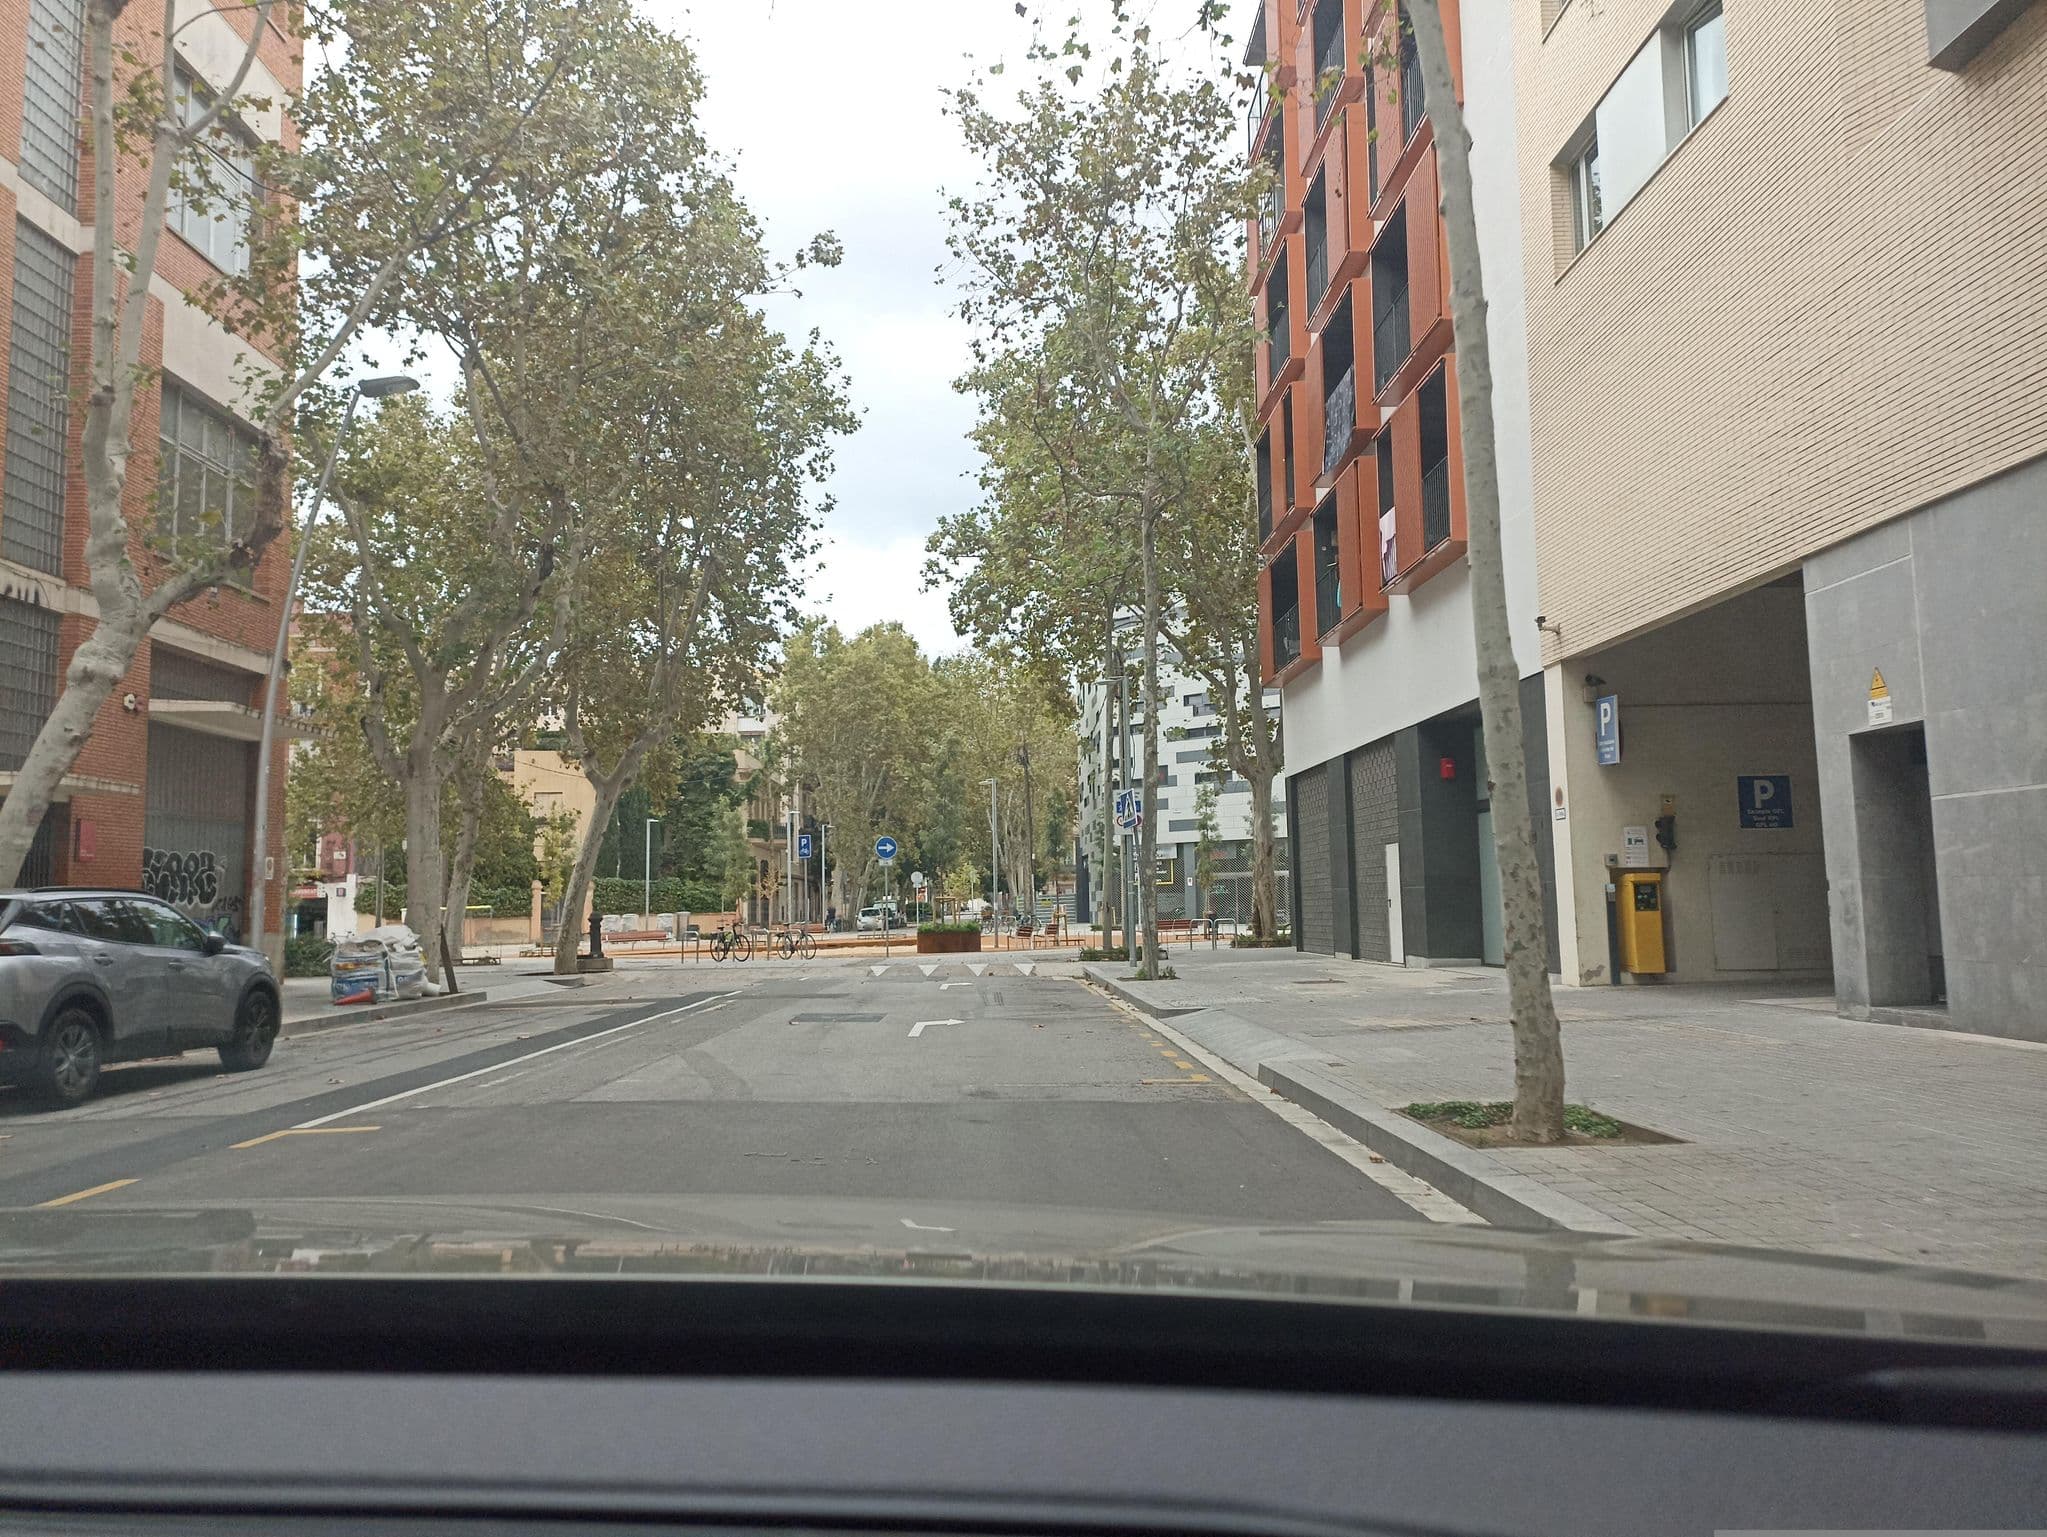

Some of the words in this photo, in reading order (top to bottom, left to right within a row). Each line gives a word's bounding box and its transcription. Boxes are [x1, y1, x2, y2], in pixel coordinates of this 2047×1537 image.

[1600, 702, 1611, 736] P
[1753, 779, 1775, 809] P
[801, 838, 807, 846] P
